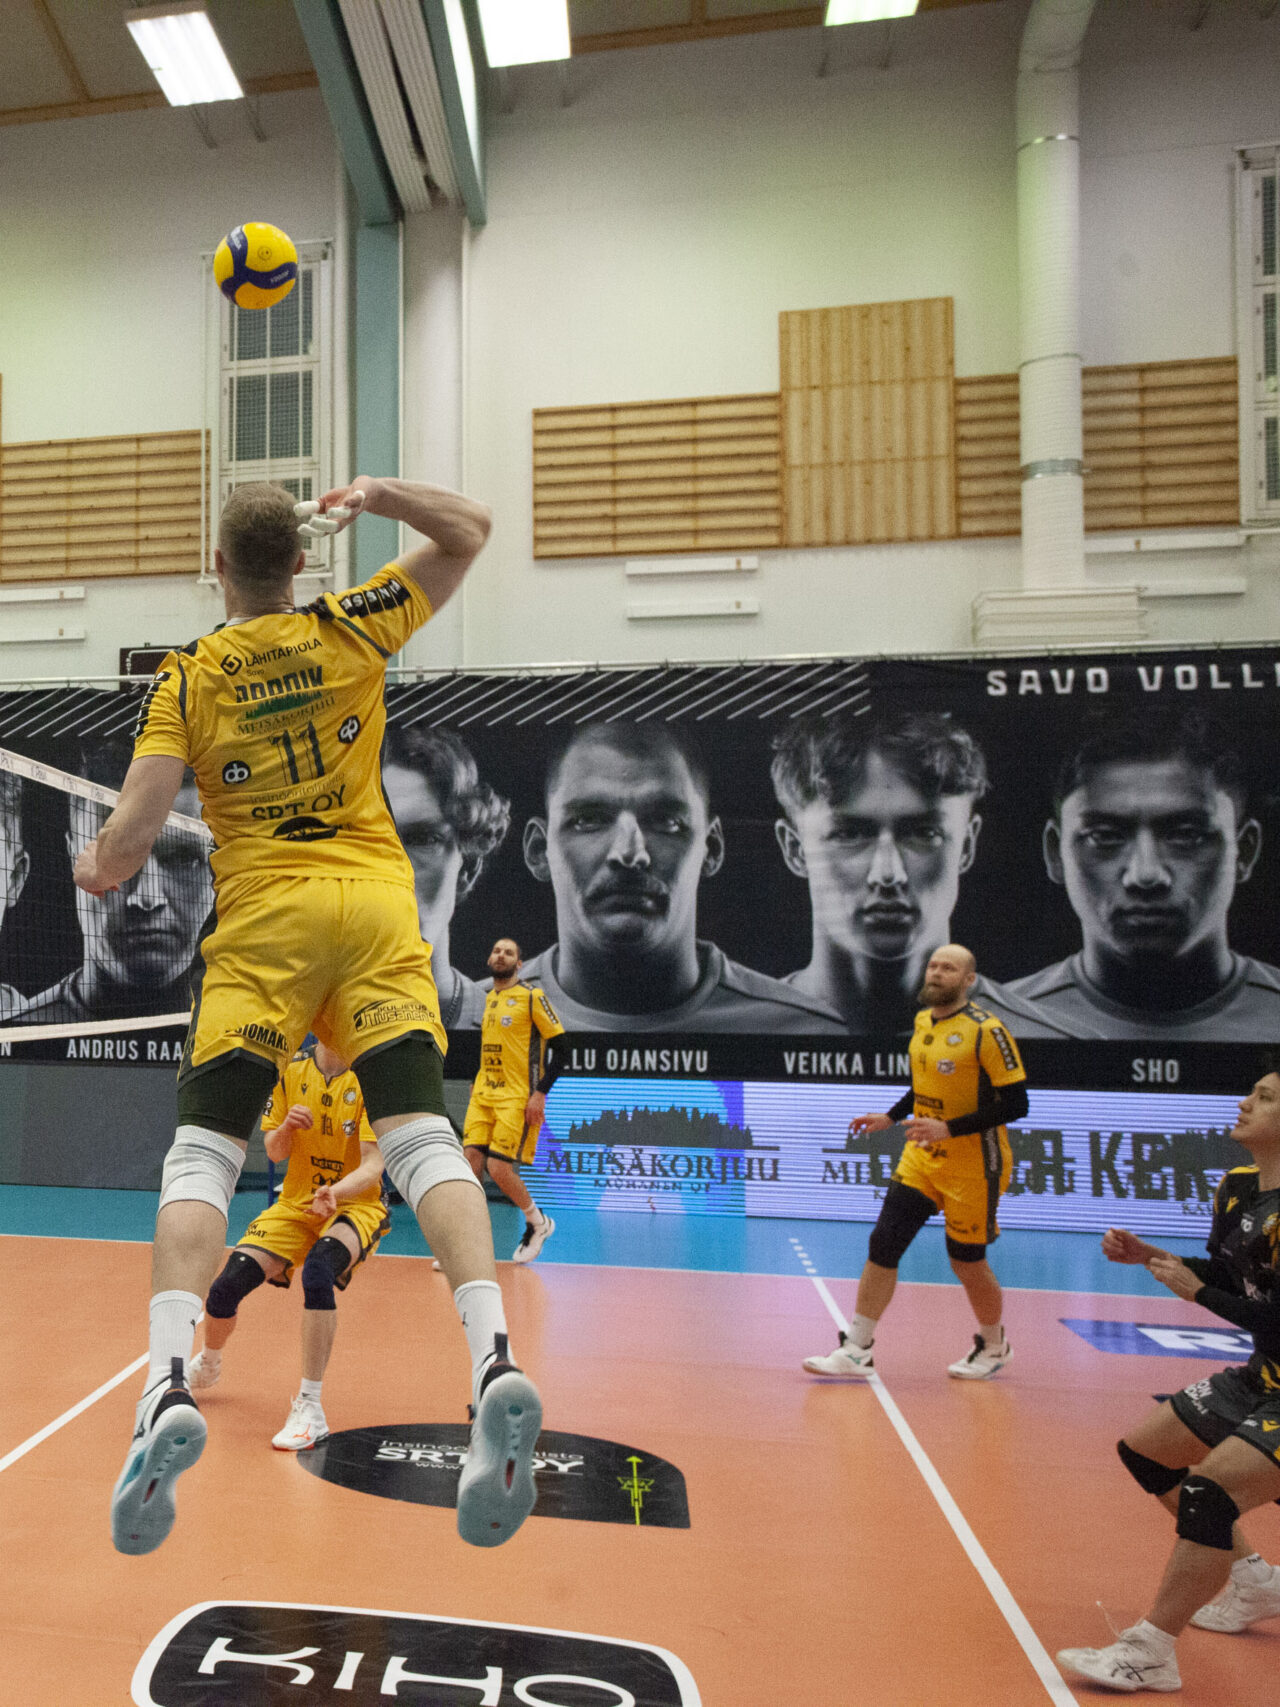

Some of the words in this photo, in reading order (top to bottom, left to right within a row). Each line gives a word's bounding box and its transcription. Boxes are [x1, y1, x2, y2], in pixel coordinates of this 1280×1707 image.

[244, 638, 323, 667] LÄHITAPIOLA
[986, 668, 1110, 696] SAVO
[1137, 661, 1280, 692] VOLL
[271, 720, 325, 784] 11
[311, 784, 346, 812] OY
[67, 1038, 139, 1059] ANDRUS
[606, 1048, 709, 1072] OJANSIVU
[784, 1051, 864, 1075] VEIKKA
[1131, 1058, 1179, 1083] SHO
[546, 1147, 780, 1182] METSÄKORJUU
